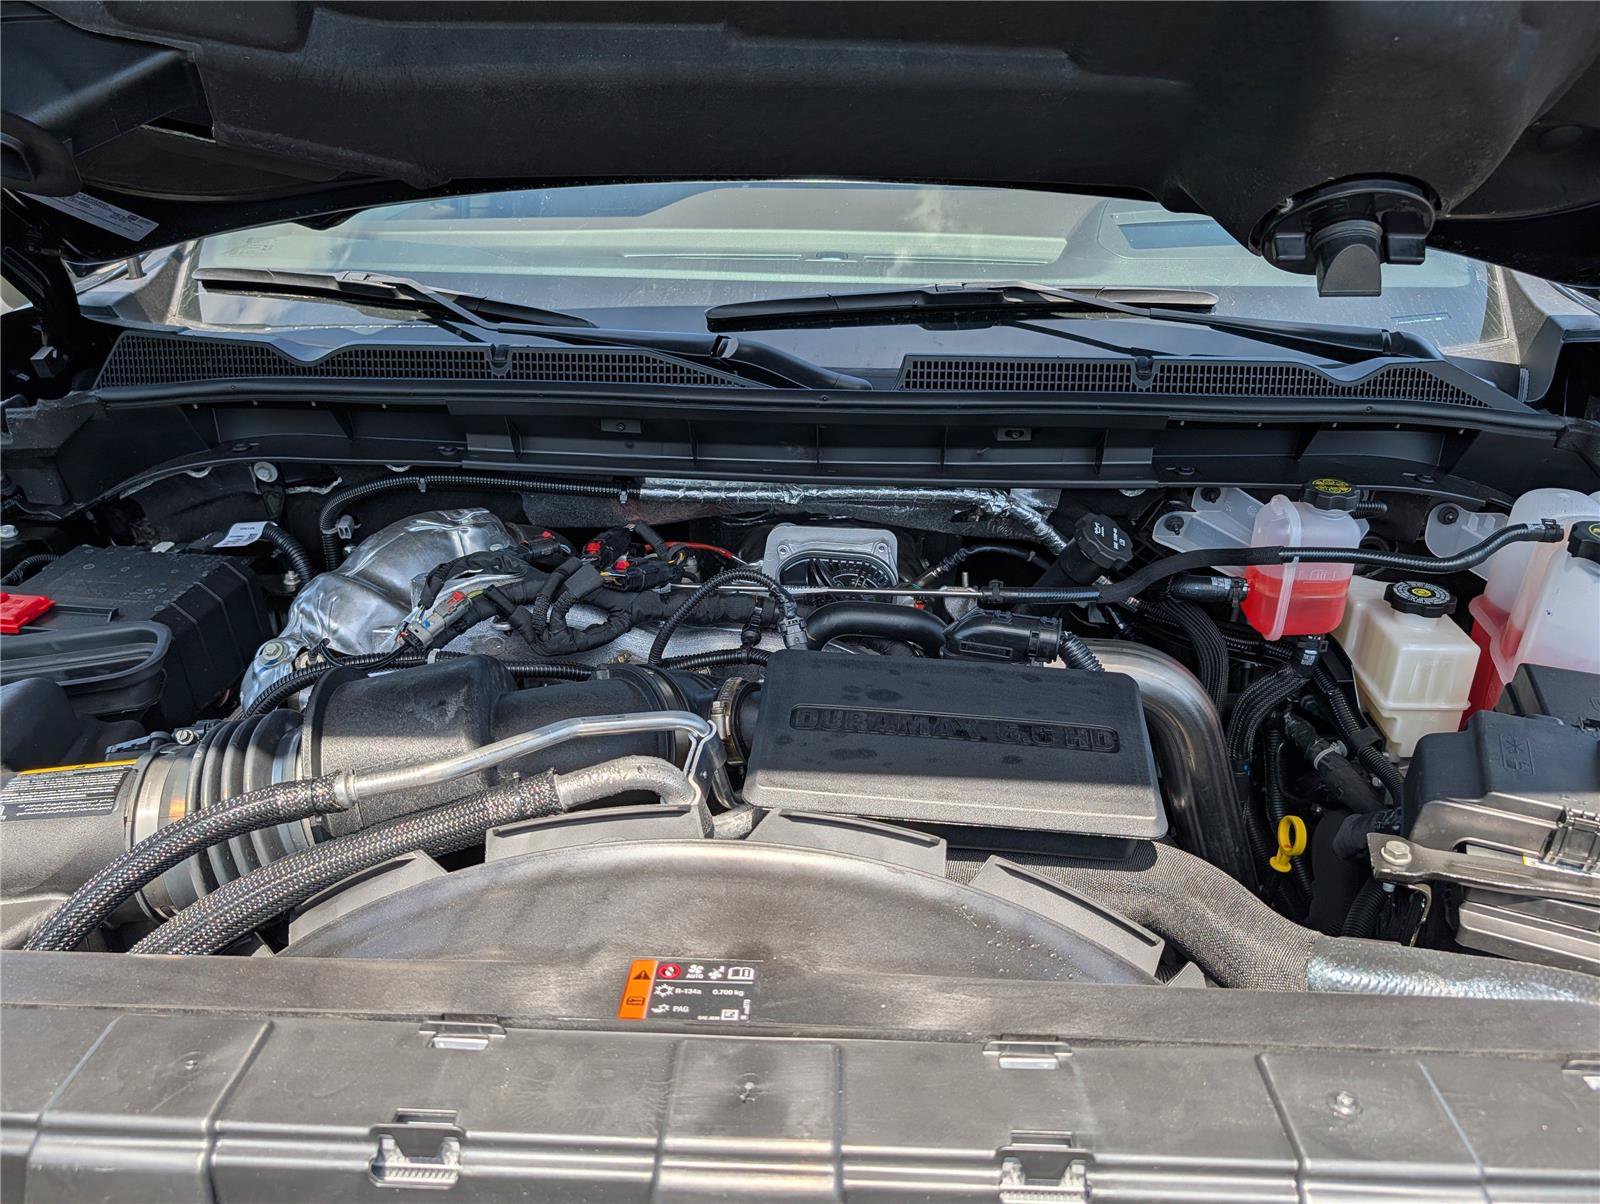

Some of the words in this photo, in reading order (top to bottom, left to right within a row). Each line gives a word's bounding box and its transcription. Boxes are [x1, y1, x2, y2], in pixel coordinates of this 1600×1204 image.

[794, 707, 981, 742] DURAMAX
[1064, 726, 1116, 752] HD
[672, 1005, 689, 1013] PAG
